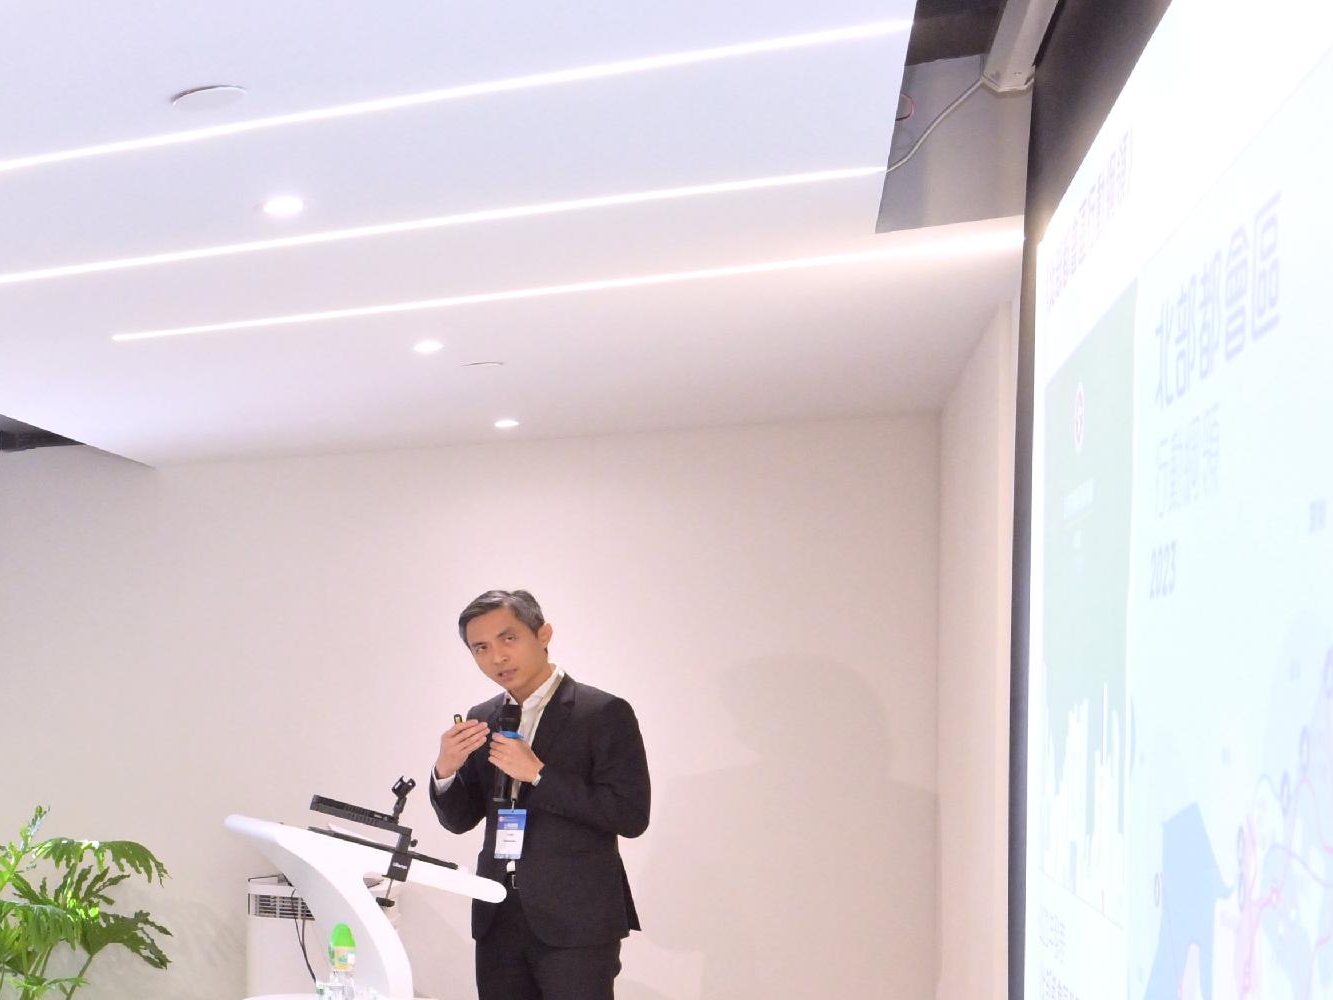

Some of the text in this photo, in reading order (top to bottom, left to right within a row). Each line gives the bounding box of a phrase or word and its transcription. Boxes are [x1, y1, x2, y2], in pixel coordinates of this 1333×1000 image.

[1154, 190, 1282, 408] 北部都會區
[1149, 540, 1178, 600] 2023
